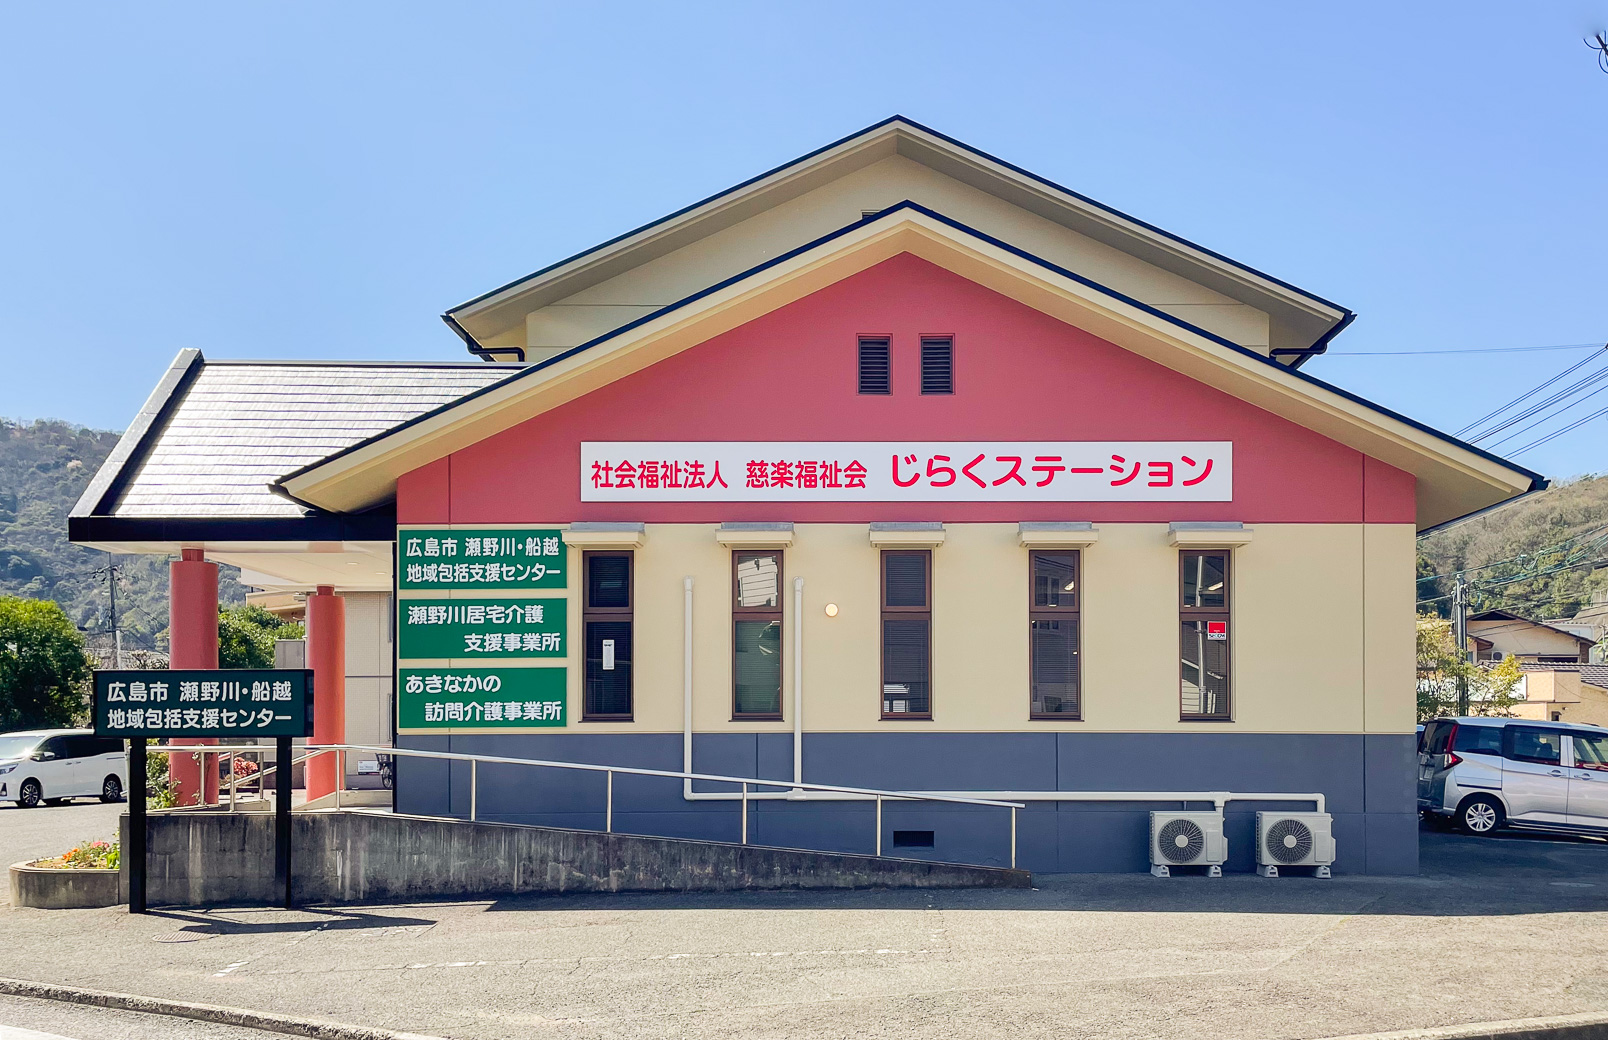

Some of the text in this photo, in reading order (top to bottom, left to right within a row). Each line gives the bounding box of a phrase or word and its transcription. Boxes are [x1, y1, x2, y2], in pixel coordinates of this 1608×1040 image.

[591, 453, 1214, 489] 社会福祉法人 慈楽福祉会 じらくステーション
[406, 536, 560, 558] 広島市 瀬野川・船越
[406, 562, 561, 583] 地域包括支援センター
[407, 604, 544, 625] 瀬野川居宅介護
[463, 632, 561, 653] 支援事業所
[106, 680, 292, 703] 広島市 瀬野川・船越
[405, 674, 502, 694] あきなかの
[106, 707, 292, 729] 地域包括支援センター
[424, 700, 563, 722] 訪問介護事業所
